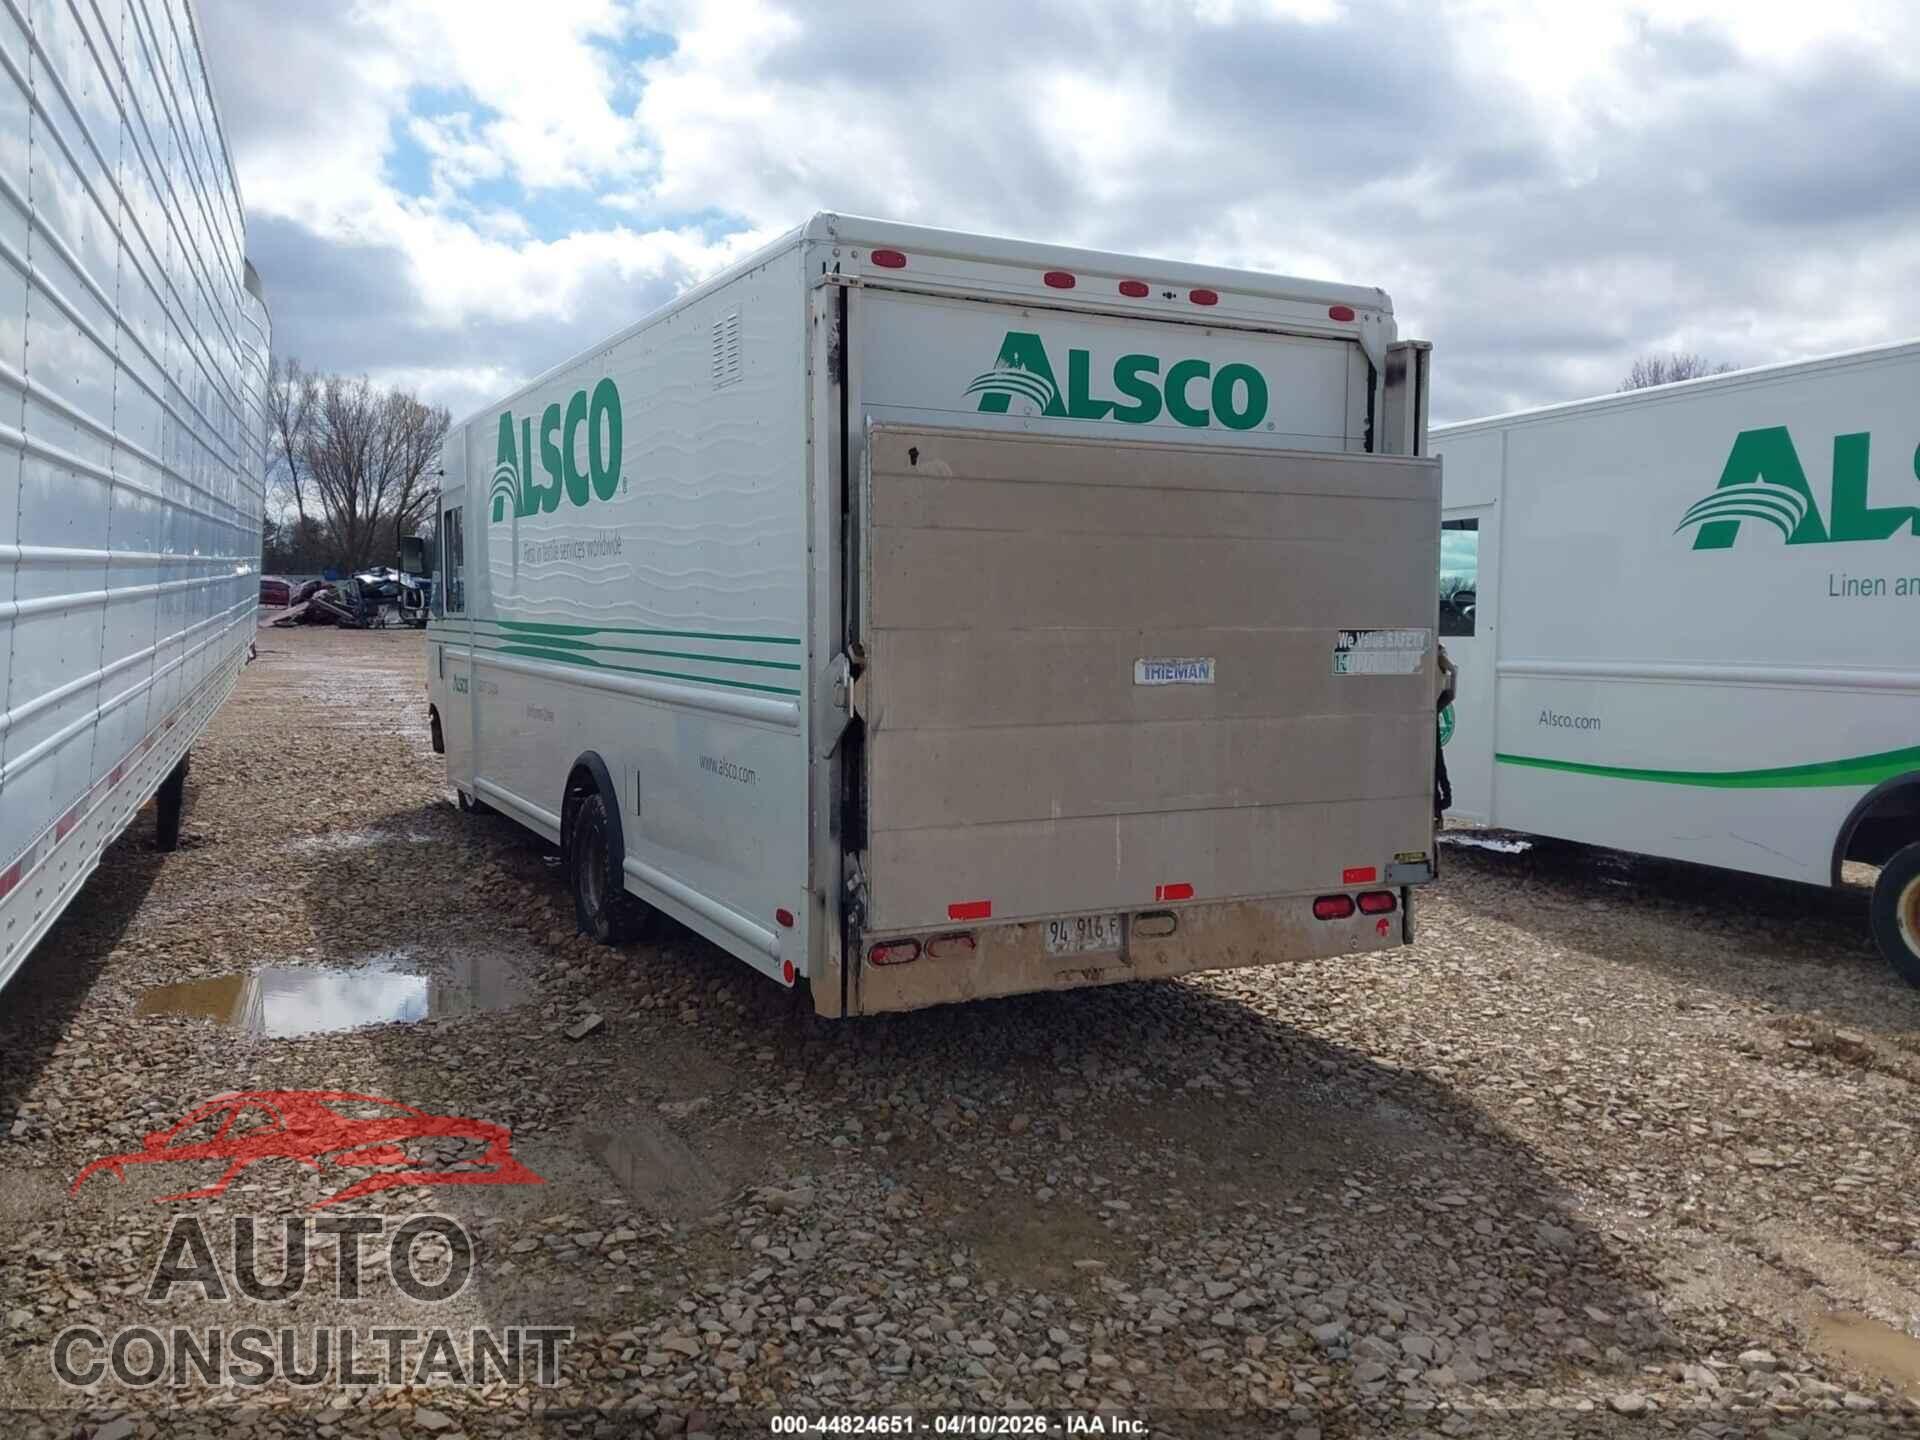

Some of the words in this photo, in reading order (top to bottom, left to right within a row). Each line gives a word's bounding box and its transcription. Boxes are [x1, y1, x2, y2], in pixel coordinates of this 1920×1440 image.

[961, 331, 1268, 430] ALSCO
[488, 377, 622, 523] ALSCO
[1672, 425, 1920, 550] AL
[1829, 574, 1886, 597] Linen
[1337, 631, 1354, 648] We
[1539, 710, 1601, 729] Alsco.com
